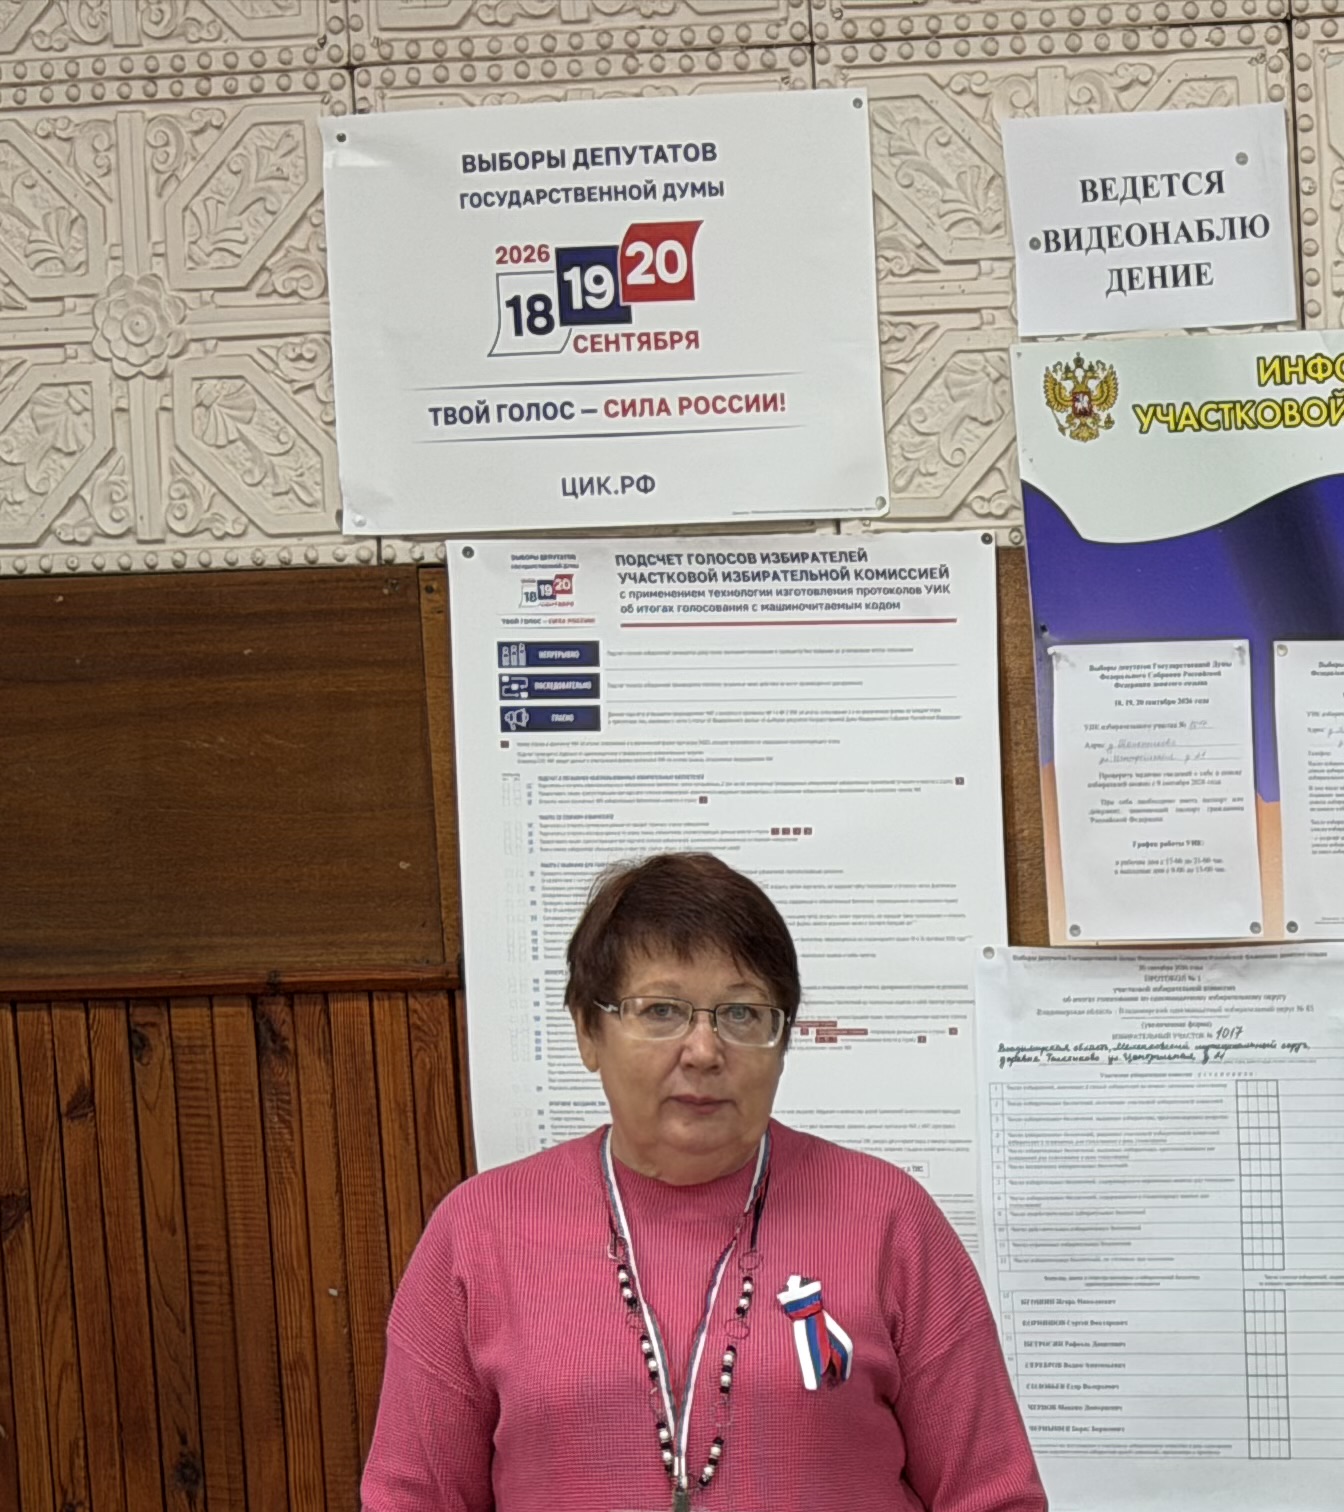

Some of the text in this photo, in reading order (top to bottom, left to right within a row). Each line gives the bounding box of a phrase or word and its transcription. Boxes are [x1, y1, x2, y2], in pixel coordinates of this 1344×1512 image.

[462, 142, 718, 174] ВЫБОРЫ ДЕПУТАТОВ
[459, 180, 725, 210] ГОСУДАРСТВЕННОЙ ДУМЫ
[1079, 169, 1226, 206] ВЕДЕТСЯ
[1041, 213, 1270, 256] ВИДЕОНАБЛЮ
[494, 244, 551, 265] 2026
[505, 239, 688, 337] 18 19 20
[1105, 261, 1214, 298] ДЕНИЕ
[572, 329, 700, 354] СЕНТЯБРЯ
[428, 399, 490, 427] ТВОЙ
[496, 401, 576, 424] ГОЛОС
[603, 398, 672, 419] СИЛА
[678, 392, 786, 417] РОССИИ!
[560, 474, 657, 500] ЦИК.РФ
[615, 548, 868, 568] ПОДСЧЕТ ГОЛОСОВ ИЗБИРАТЕЛЕЙ
[618, 563, 949, 585] УЧАСТКОВОЙ ИЗБИРАТЕЛЬНОЙ КОМИССИЕЙ
[523, 578, 571, 603] 18 19 20
[619, 584, 951, 602] с применением технологии изготовления протоколов УИК
[620, 603, 634, 614] об
[636, 604, 674, 614] итогах
[677, 603, 749, 614] голосования
[752, 604, 758, 613] с
[864, 601, 901, 612] кодом
[1215, 1025, 1244, 1040] 1017
